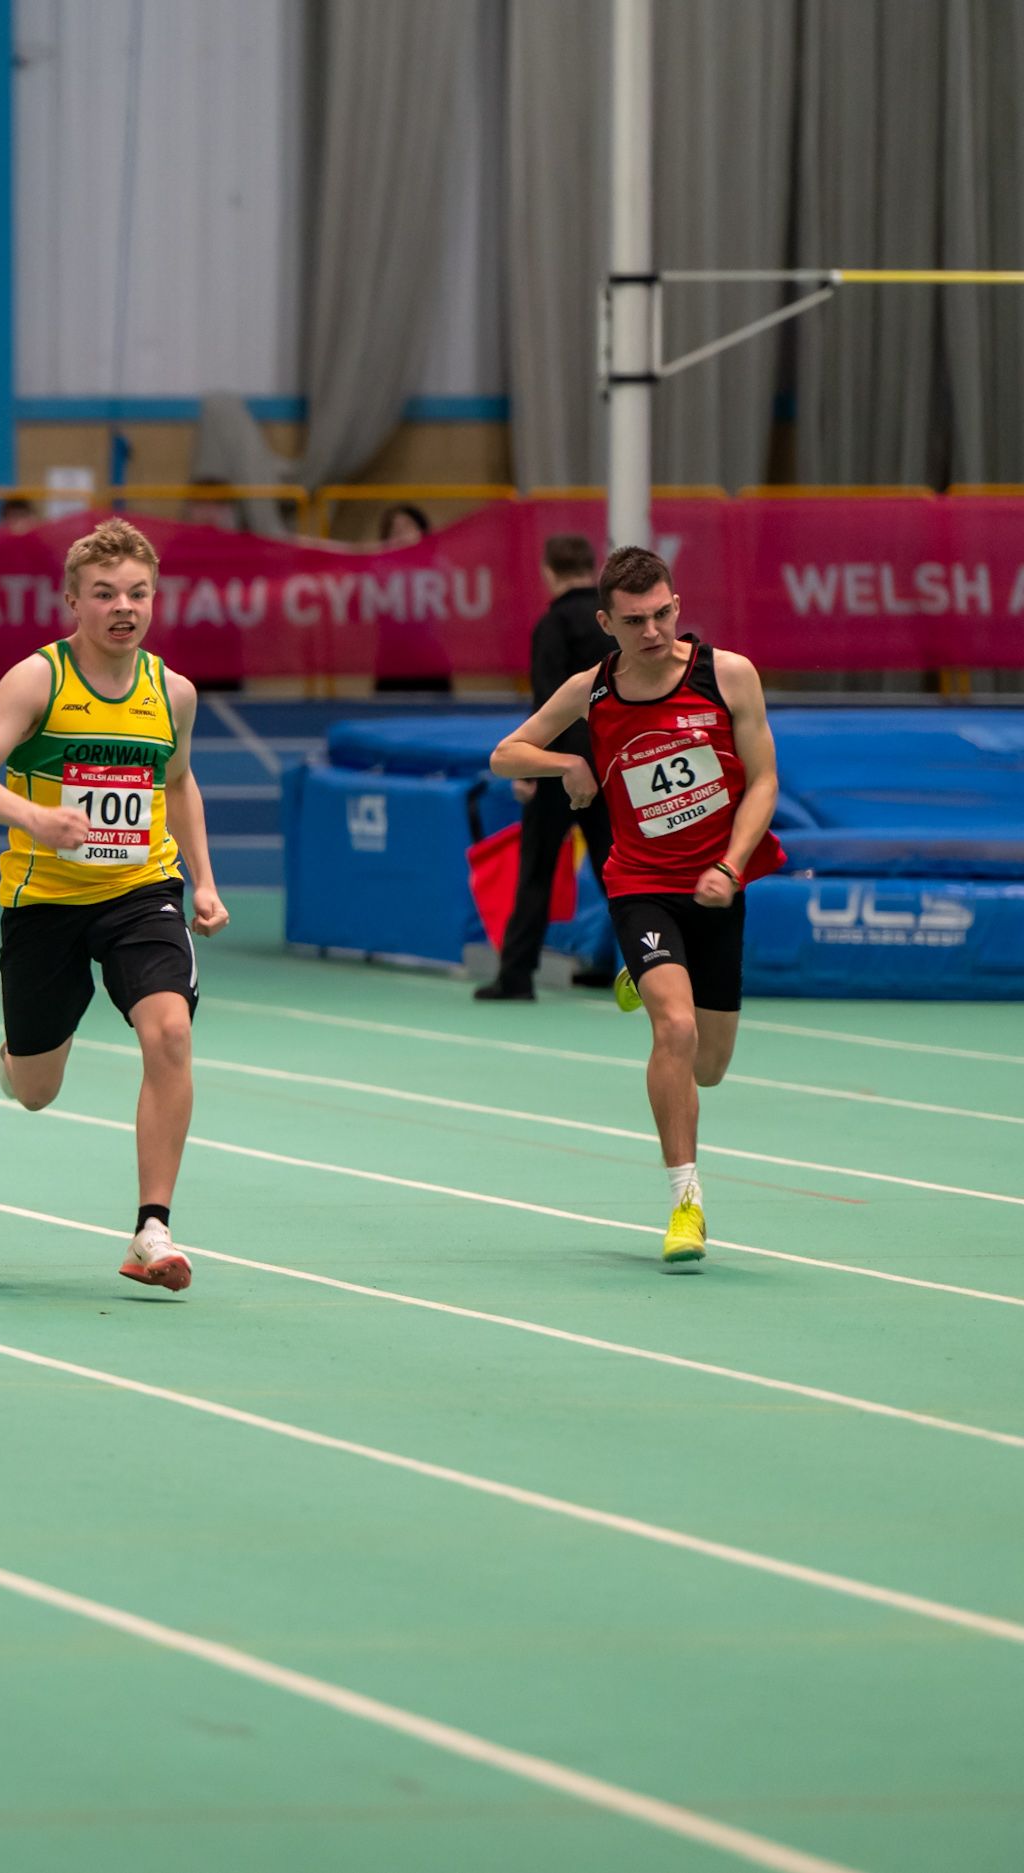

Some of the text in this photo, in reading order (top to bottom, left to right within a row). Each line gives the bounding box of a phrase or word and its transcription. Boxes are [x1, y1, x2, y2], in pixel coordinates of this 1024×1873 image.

[282, 566, 493, 626] CYMRU
[781, 562, 991, 616] WELSH
[63, 743, 159, 767] CORNWALL
[632, 738, 692, 761] WELSH ATHLETICS
[81, 773, 142, 783] WELSH ATHLETICS
[651, 756, 696, 794] 43
[77, 790, 142, 827] 100
[642, 783, 721, 819] ROBERTS-JONES
[87, 831, 142, 845] RRAY T/F20
